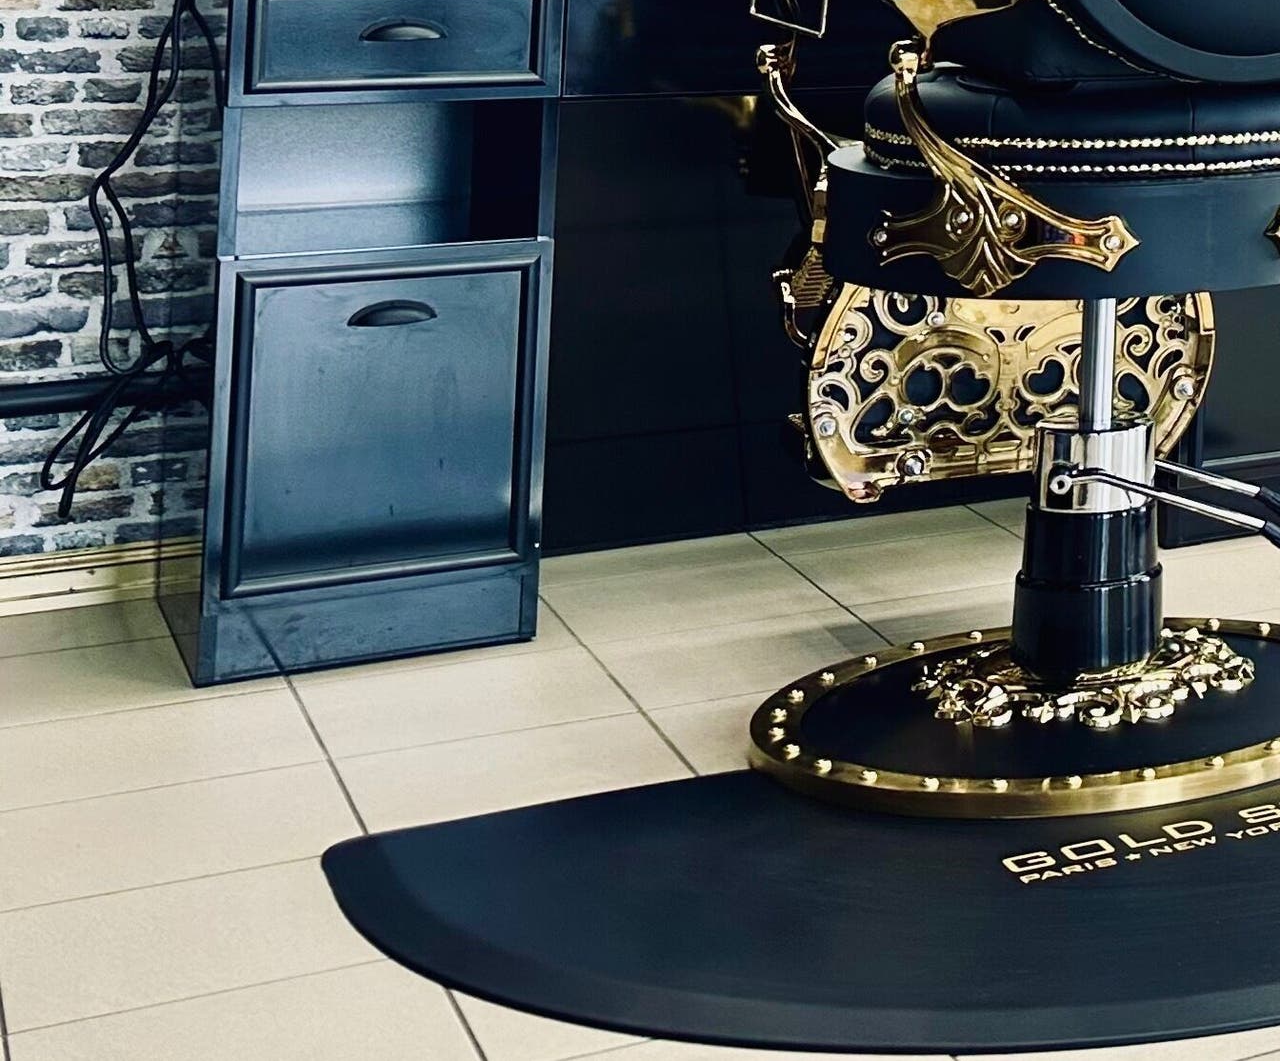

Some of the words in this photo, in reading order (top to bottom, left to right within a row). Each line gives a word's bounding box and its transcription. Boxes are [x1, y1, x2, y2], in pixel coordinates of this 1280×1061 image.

[1002, 820, 1213, 873] GOLD
[1019, 857, 1118, 884] PARIS
[1149, 836, 1217, 857] NEW
